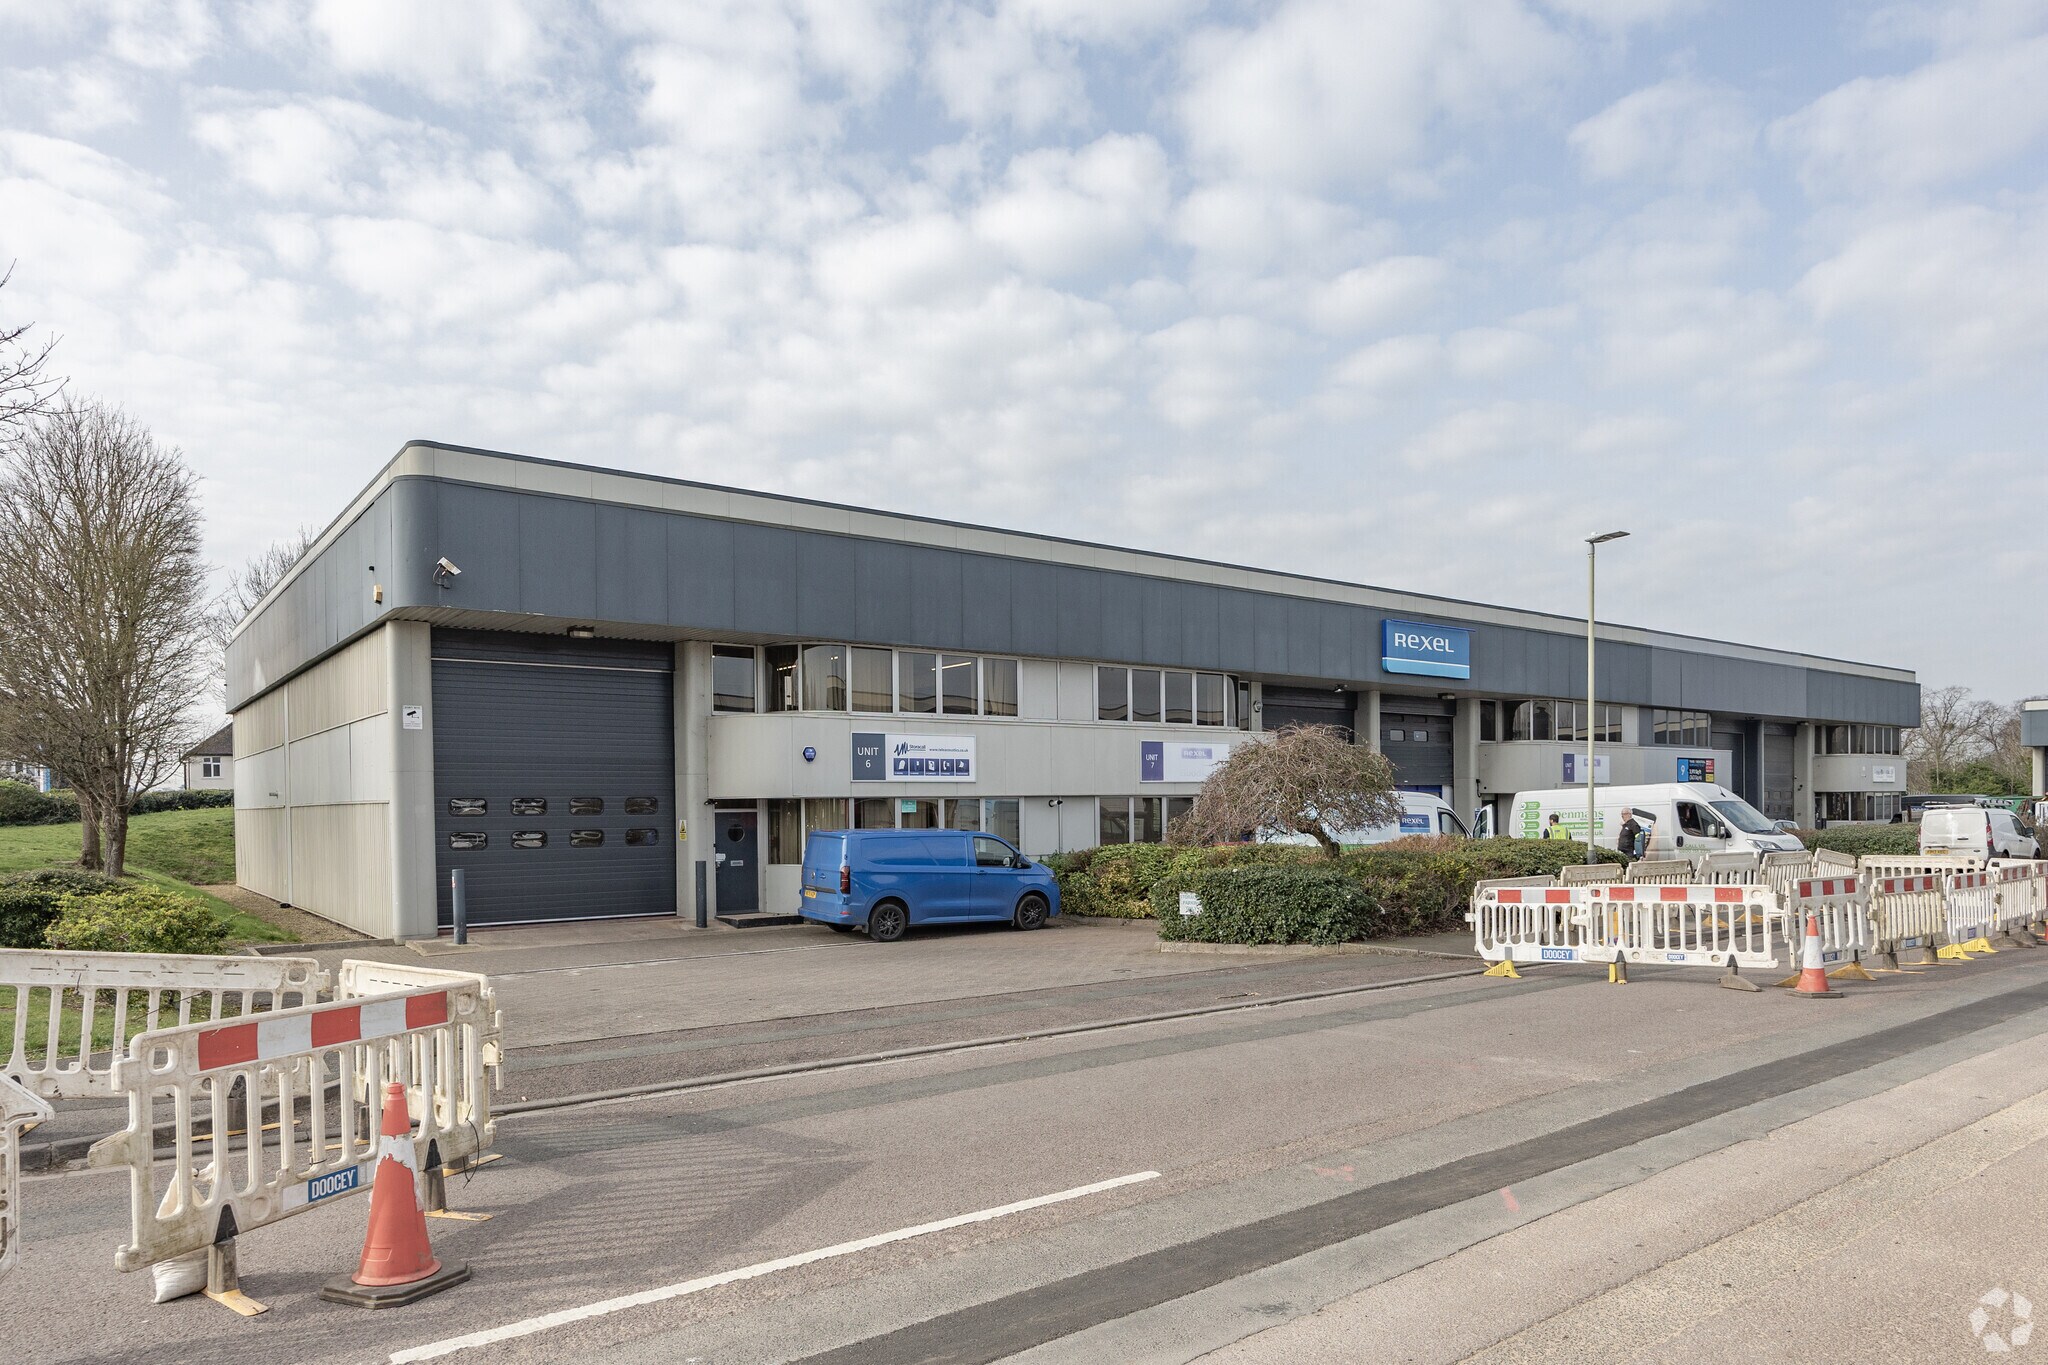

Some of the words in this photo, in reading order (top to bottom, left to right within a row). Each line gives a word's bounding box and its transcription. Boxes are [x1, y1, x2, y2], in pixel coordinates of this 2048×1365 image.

[857, 747, 879, 756] UNIT
[865, 760, 871, 768] 6
[1680, 764, 1686, 776] 9
[1543, 949, 1571, 960] DOOCEY
[311, 1169, 354, 1199] DOOCEY
